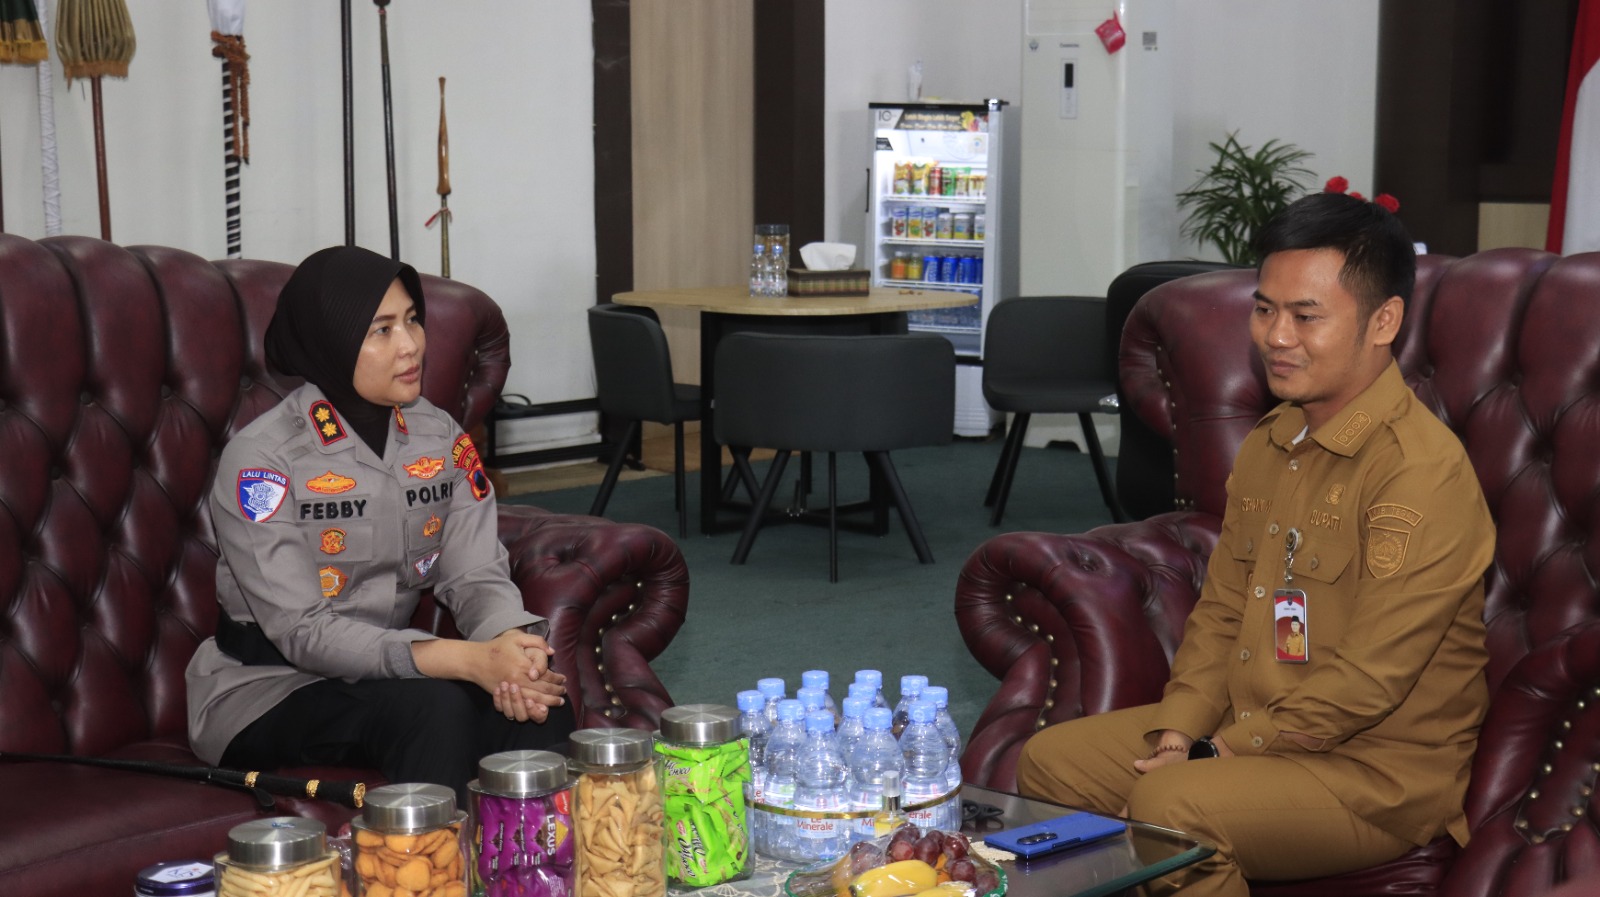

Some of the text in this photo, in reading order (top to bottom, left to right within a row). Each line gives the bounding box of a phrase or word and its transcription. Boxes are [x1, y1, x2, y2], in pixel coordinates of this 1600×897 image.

[263, 472, 287, 485] LINTAS
[406, 481, 453, 507] POLRI
[300, 499, 366, 520] FEBBY
[546, 814, 556, 856] LEXUS
[797, 820, 833, 831] Minerale
